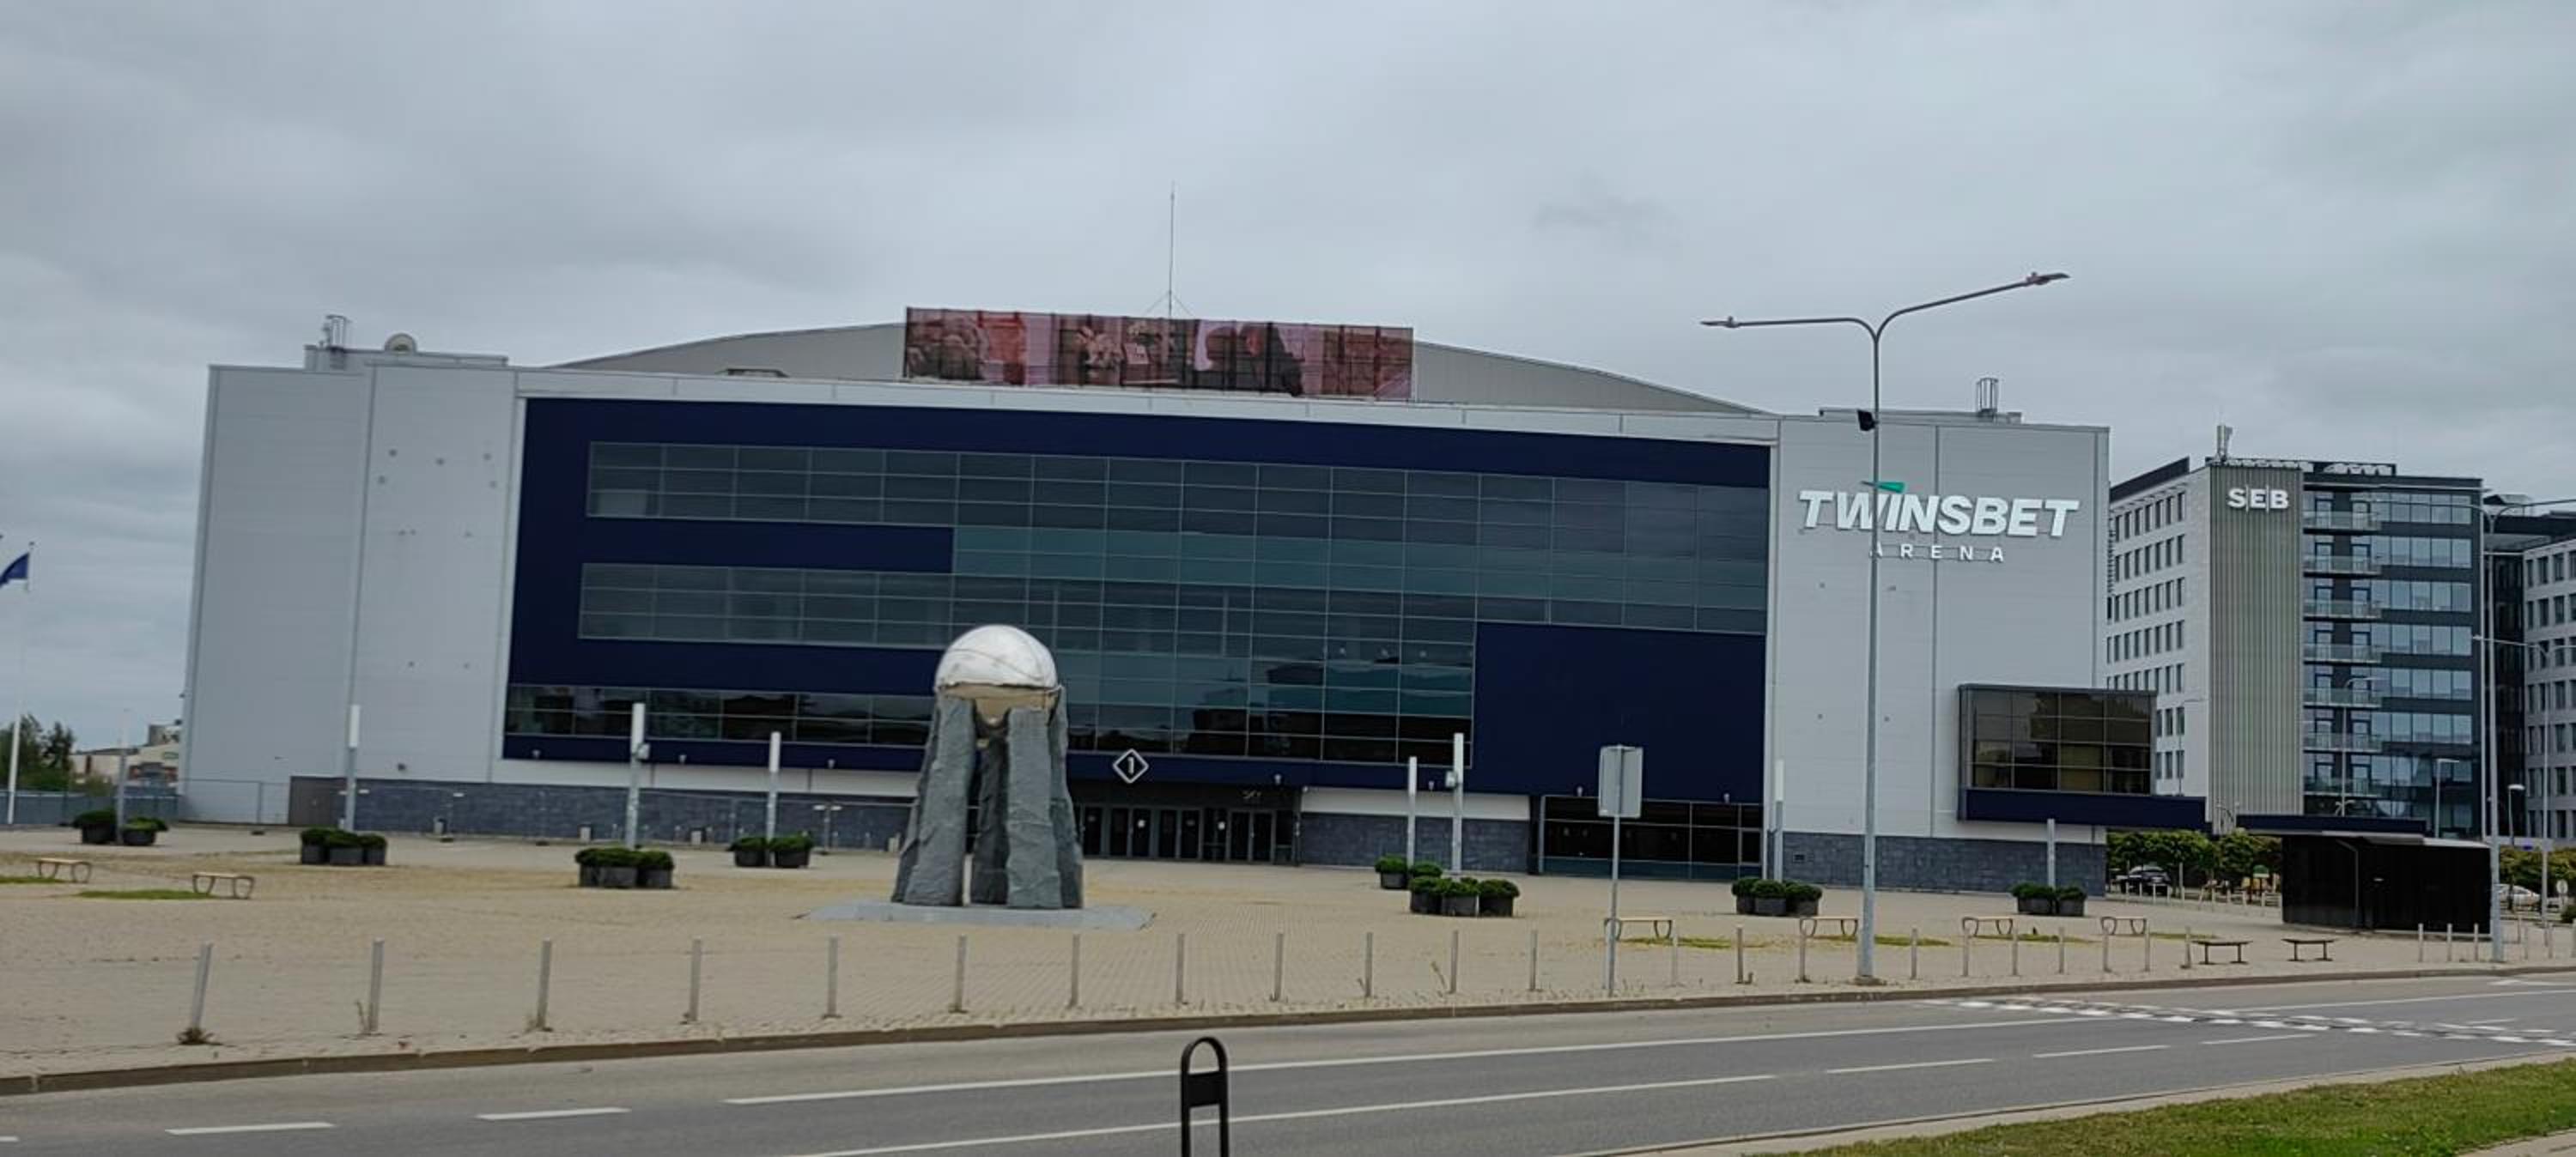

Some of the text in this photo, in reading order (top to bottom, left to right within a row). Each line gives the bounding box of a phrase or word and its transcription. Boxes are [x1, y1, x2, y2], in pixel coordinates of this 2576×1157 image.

[2227, 487, 2289, 510] SEB
[1799, 488, 2081, 537] TWINSBET
[1127, 756, 1135, 775] 1
